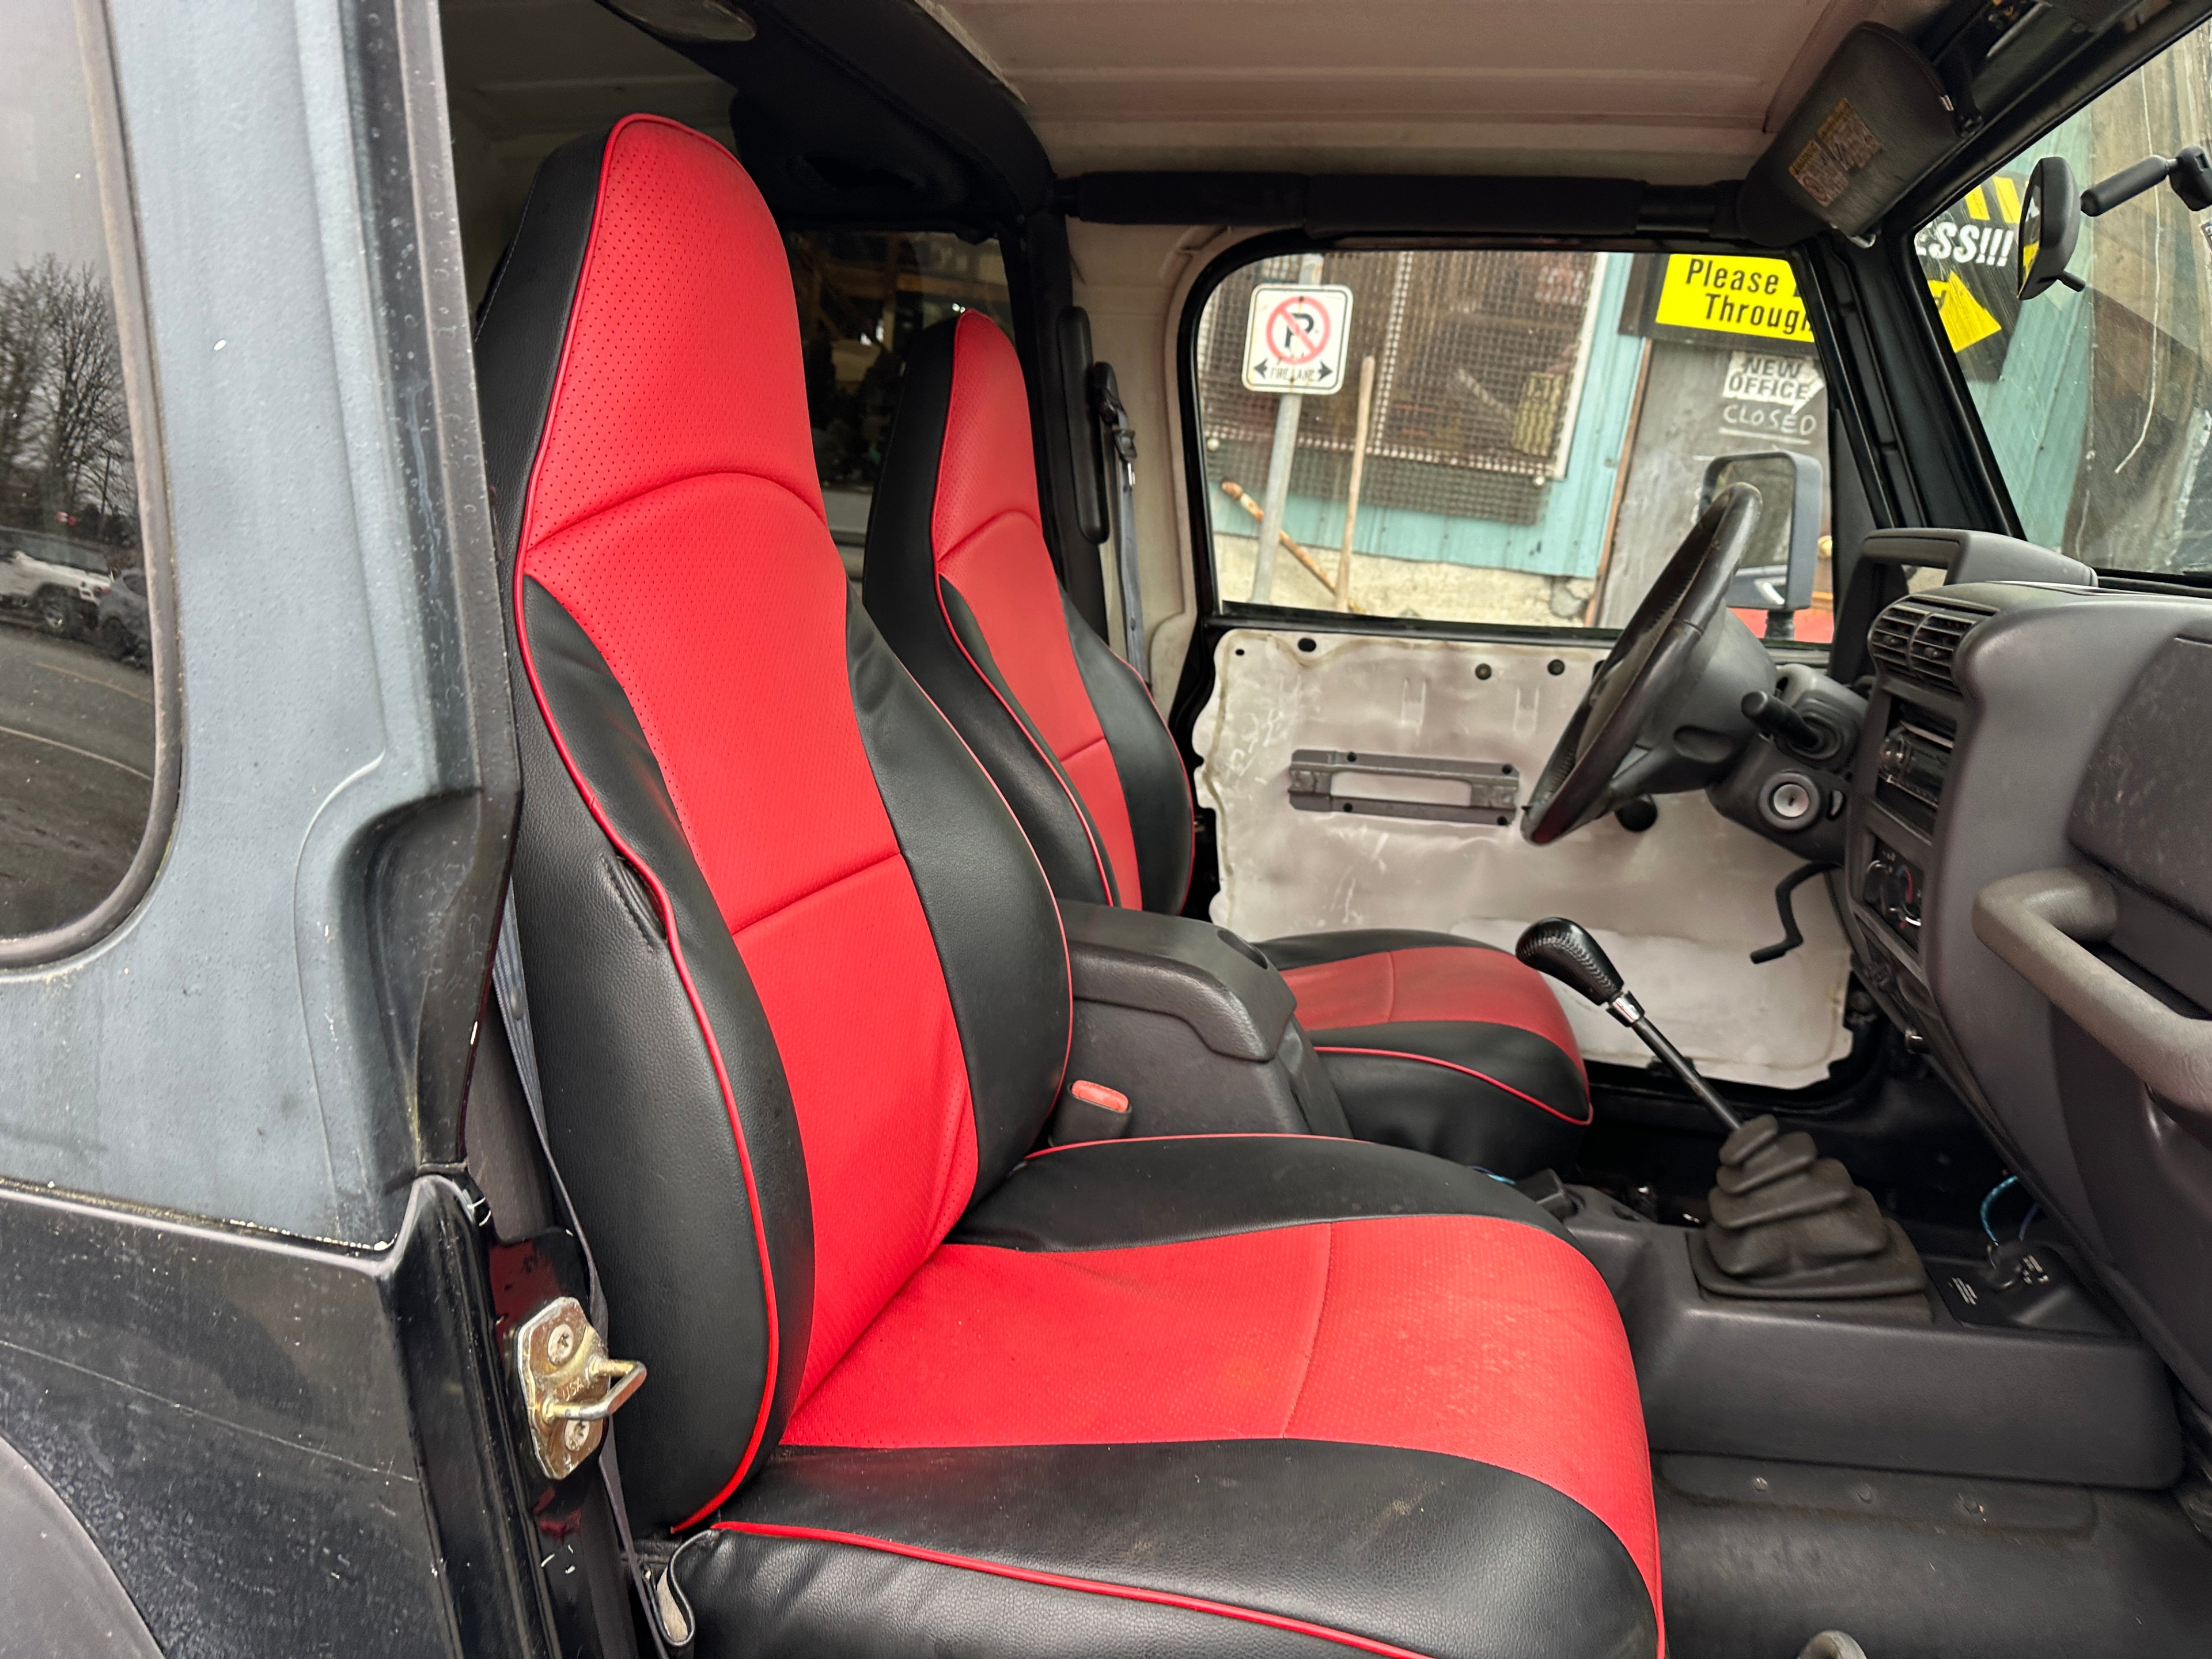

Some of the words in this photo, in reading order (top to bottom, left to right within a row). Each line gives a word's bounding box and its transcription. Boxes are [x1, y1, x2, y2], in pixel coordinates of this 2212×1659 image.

[1685, 258, 1779, 295] Please
[1743, 357, 1803, 377] NEW
[1729, 374, 1810, 400] OFFICE
[562, 1376, 584, 1402] USA
